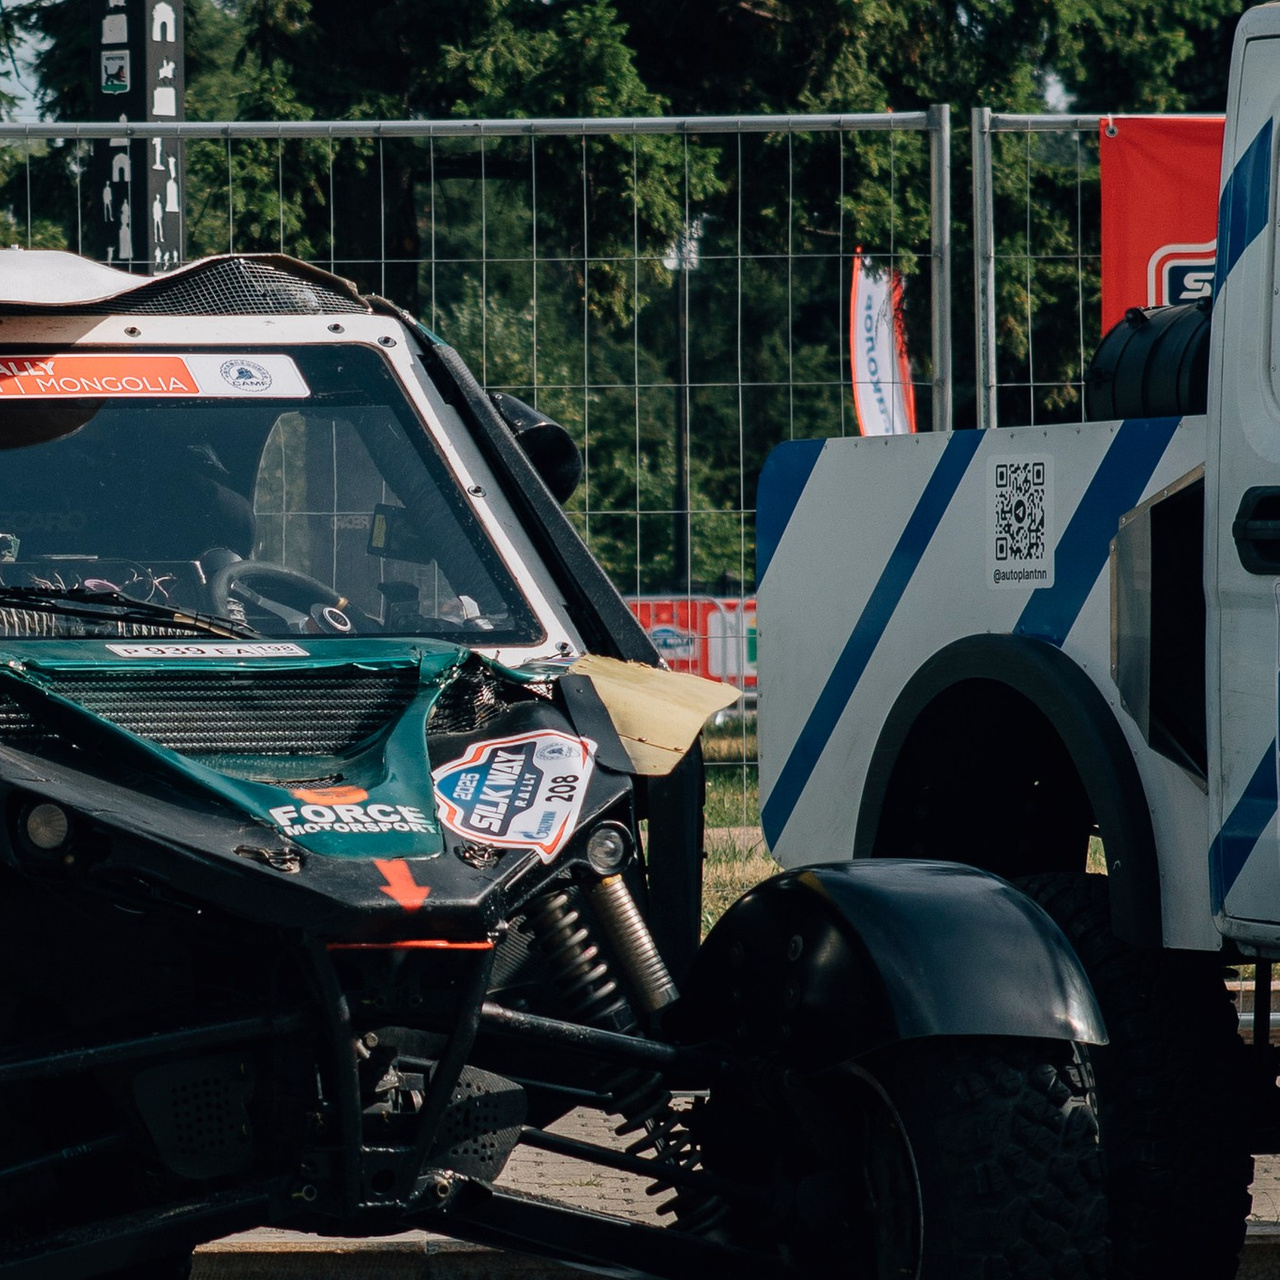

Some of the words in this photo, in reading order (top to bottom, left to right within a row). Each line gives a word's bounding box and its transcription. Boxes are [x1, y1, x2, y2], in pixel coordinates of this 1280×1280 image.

[36, 376, 190, 393] MONGOLIA
[993, 568, 1047, 584] @autoplantnn
[144, 646, 206, 656] 939
[485, 750, 526, 786] WAY
[452, 773, 481, 801] 2025
[514, 773, 537, 807] RALLY
[545, 774, 580, 803] 208
[269, 803, 433, 826] FORCE
[470, 786, 516, 833] SILK
[283, 822, 438, 837] MOTORSPORT
